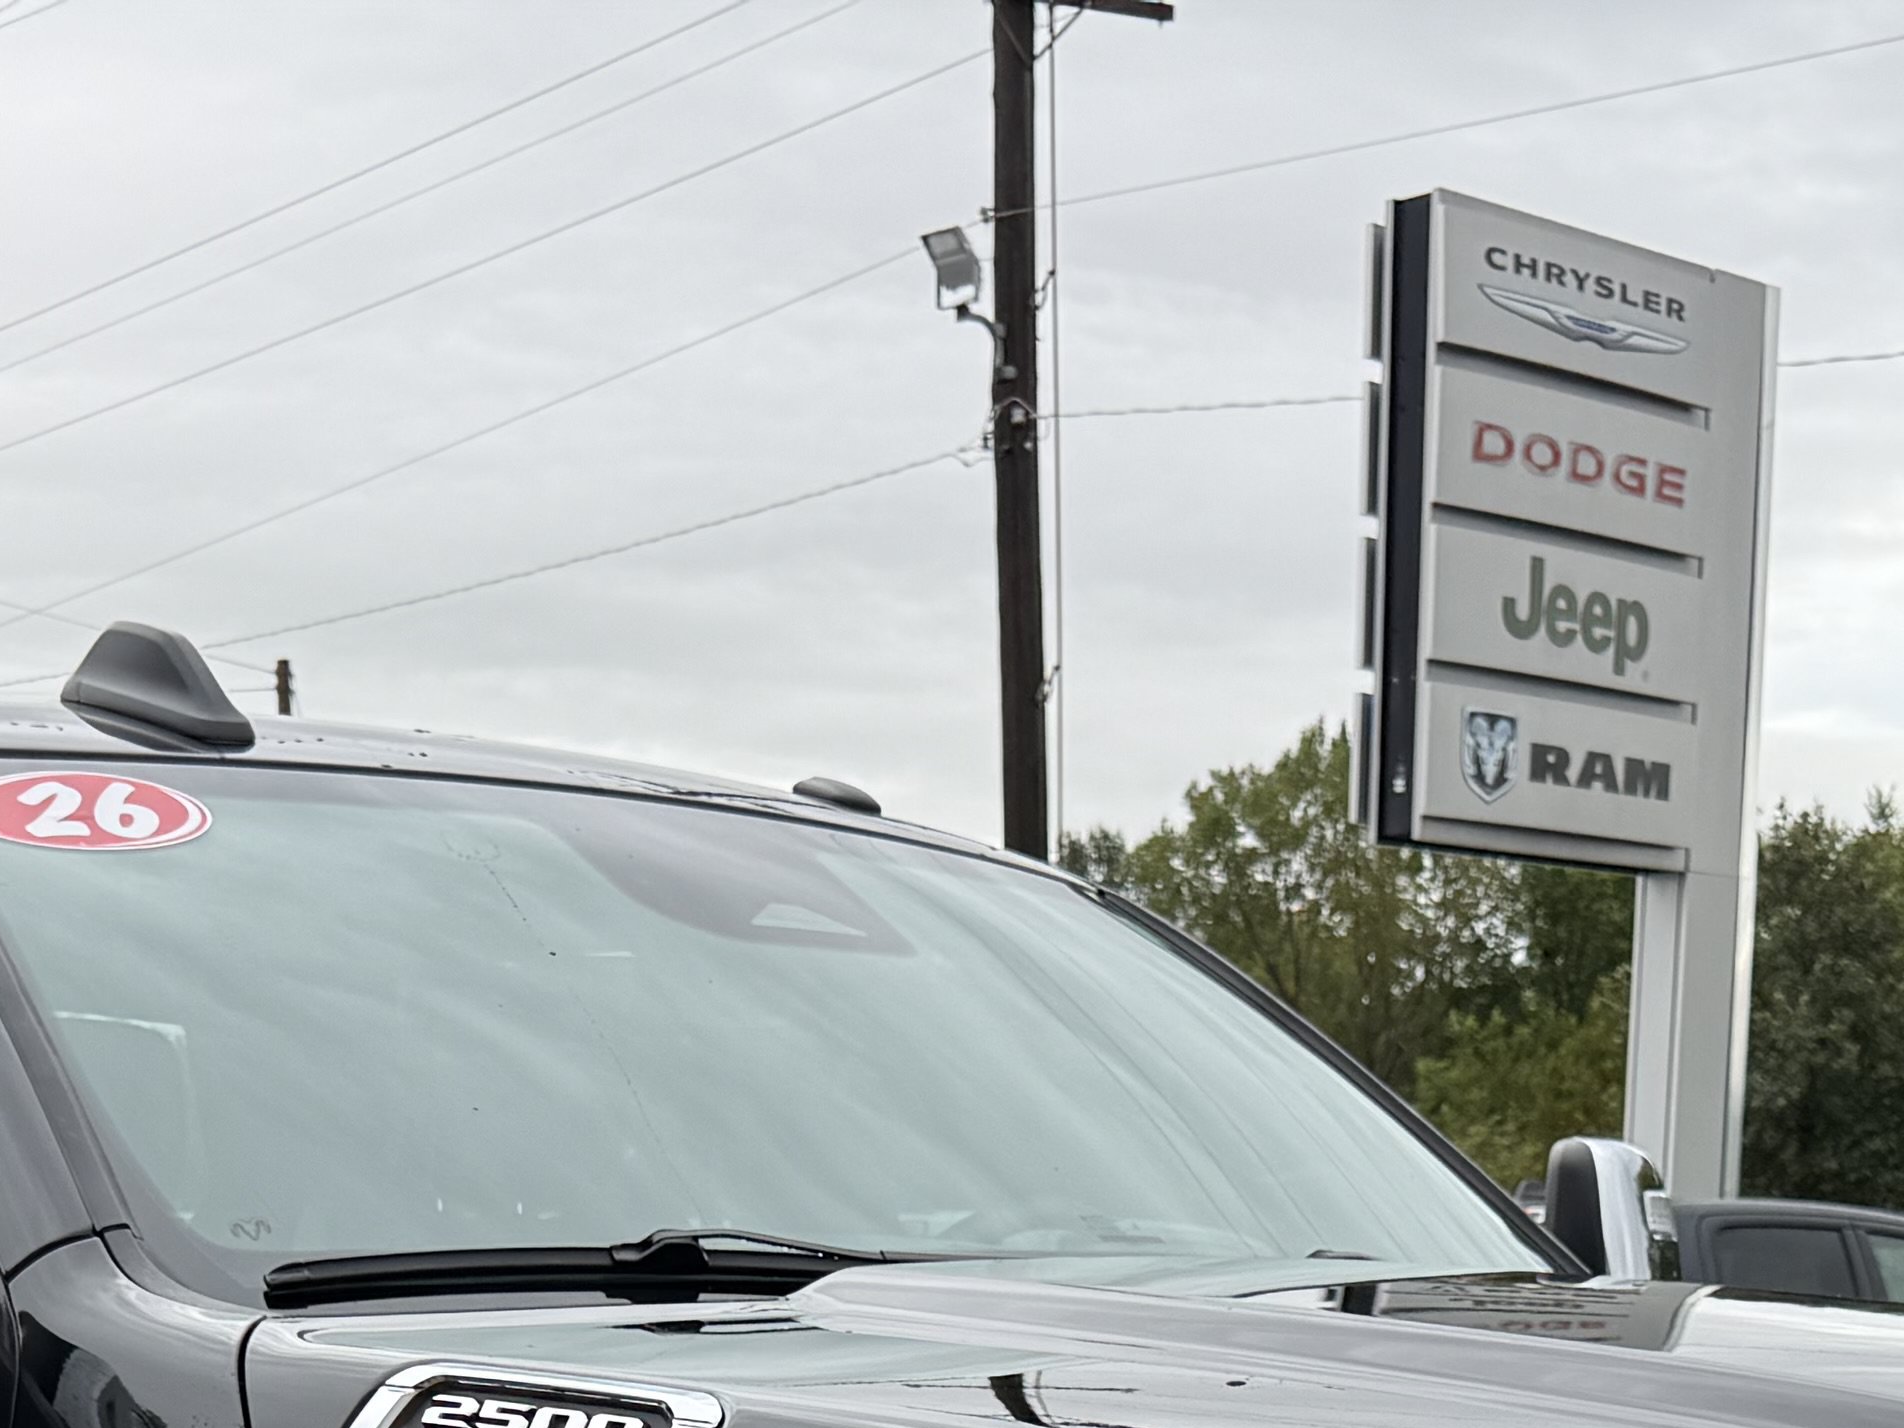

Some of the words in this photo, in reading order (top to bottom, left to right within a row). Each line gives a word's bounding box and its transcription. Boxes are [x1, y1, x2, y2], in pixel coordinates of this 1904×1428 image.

[1484, 247, 1687, 322] CHRYSLER
[1472, 420, 1687, 507] DODGE
[1501, 556, 1650, 676] Jeep
[16, 781, 160, 838] 26
[1529, 742, 1671, 802] RAM
